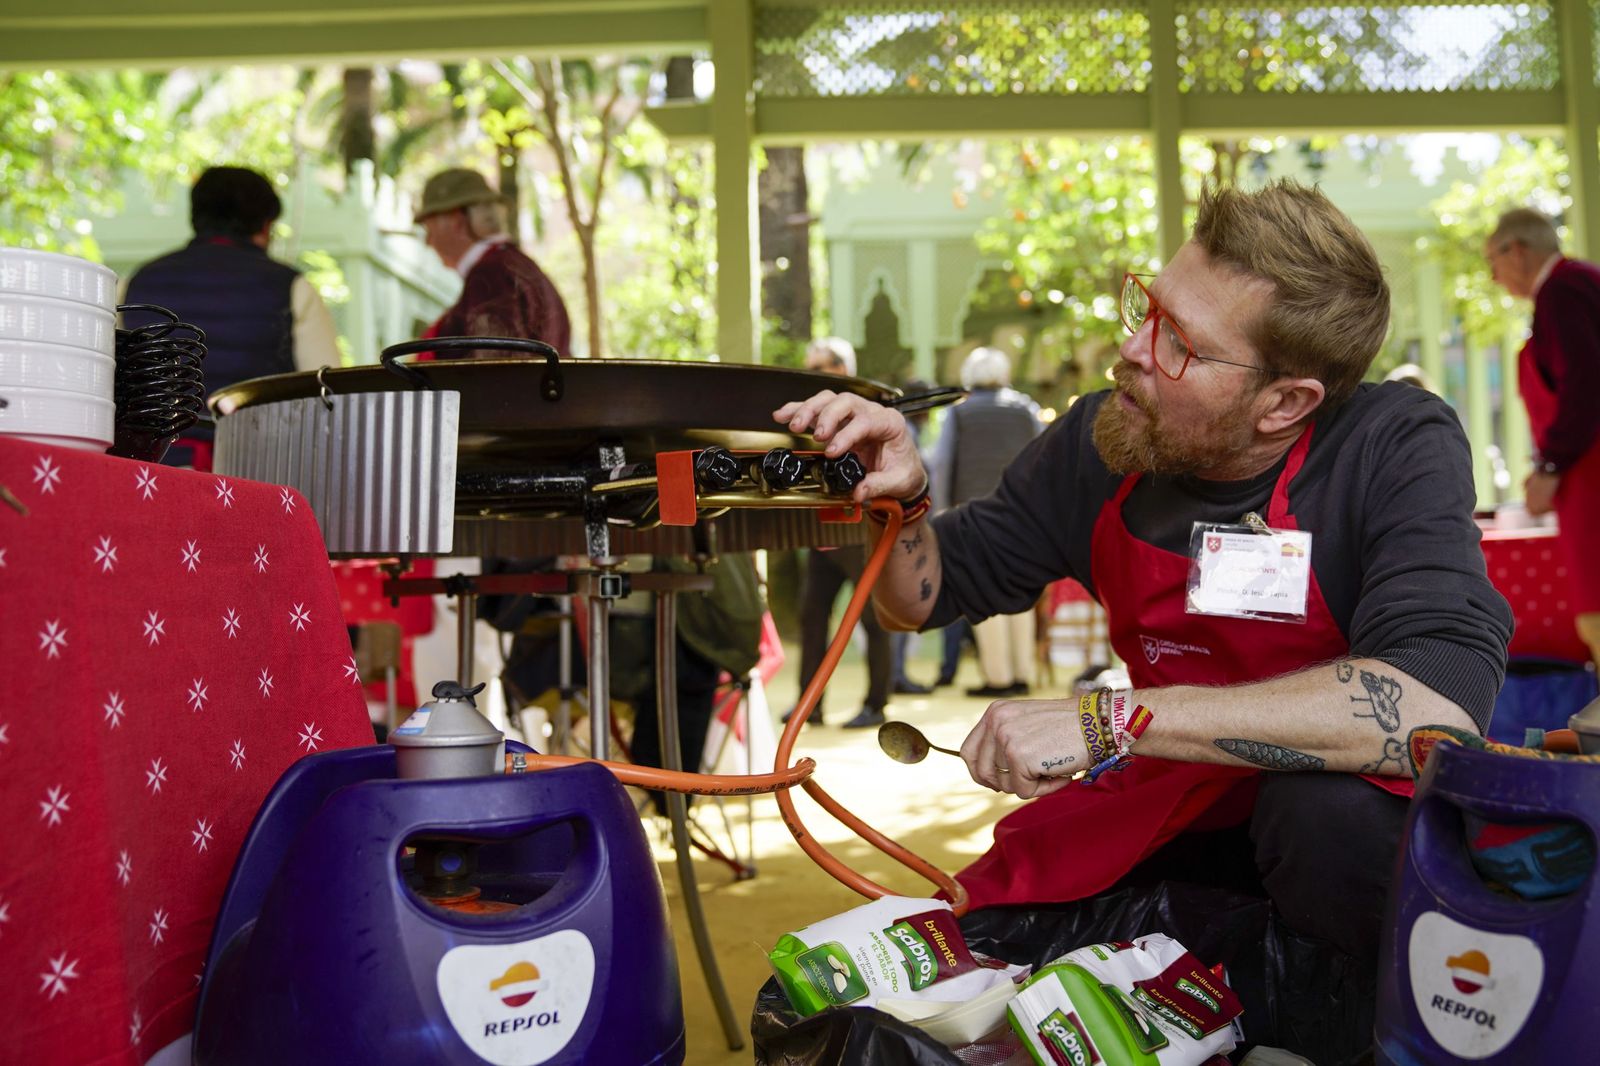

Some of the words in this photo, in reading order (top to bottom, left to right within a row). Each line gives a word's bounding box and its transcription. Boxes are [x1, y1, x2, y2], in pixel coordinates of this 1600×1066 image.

[869, 931, 893, 965] ABSORBE
[890, 966, 899, 993] TODO
[871, 943, 879, 953] EL
[876, 953, 890, 981] SABOR
[891, 927, 932, 985] sabroz
[923, 919, 958, 969] brillante
[807, 959, 823, 978] ARROZ
[818, 975, 837, 1005] REDONDO
[856, 953, 862, 962] su
[859, 963, 871, 982] punto
[858, 946, 874, 976] siempre
[872, 976, 878, 986] en
[1189, 970, 1224, 999] brillante
[1150, 987, 1206, 1025] brillante
[1177, 982, 1218, 1012] sabroz
[1431, 993, 1497, 1030] REPSOL
[484, 1009, 562, 1037] REPSOL
[1043, 1018, 1086, 1066] sabro
